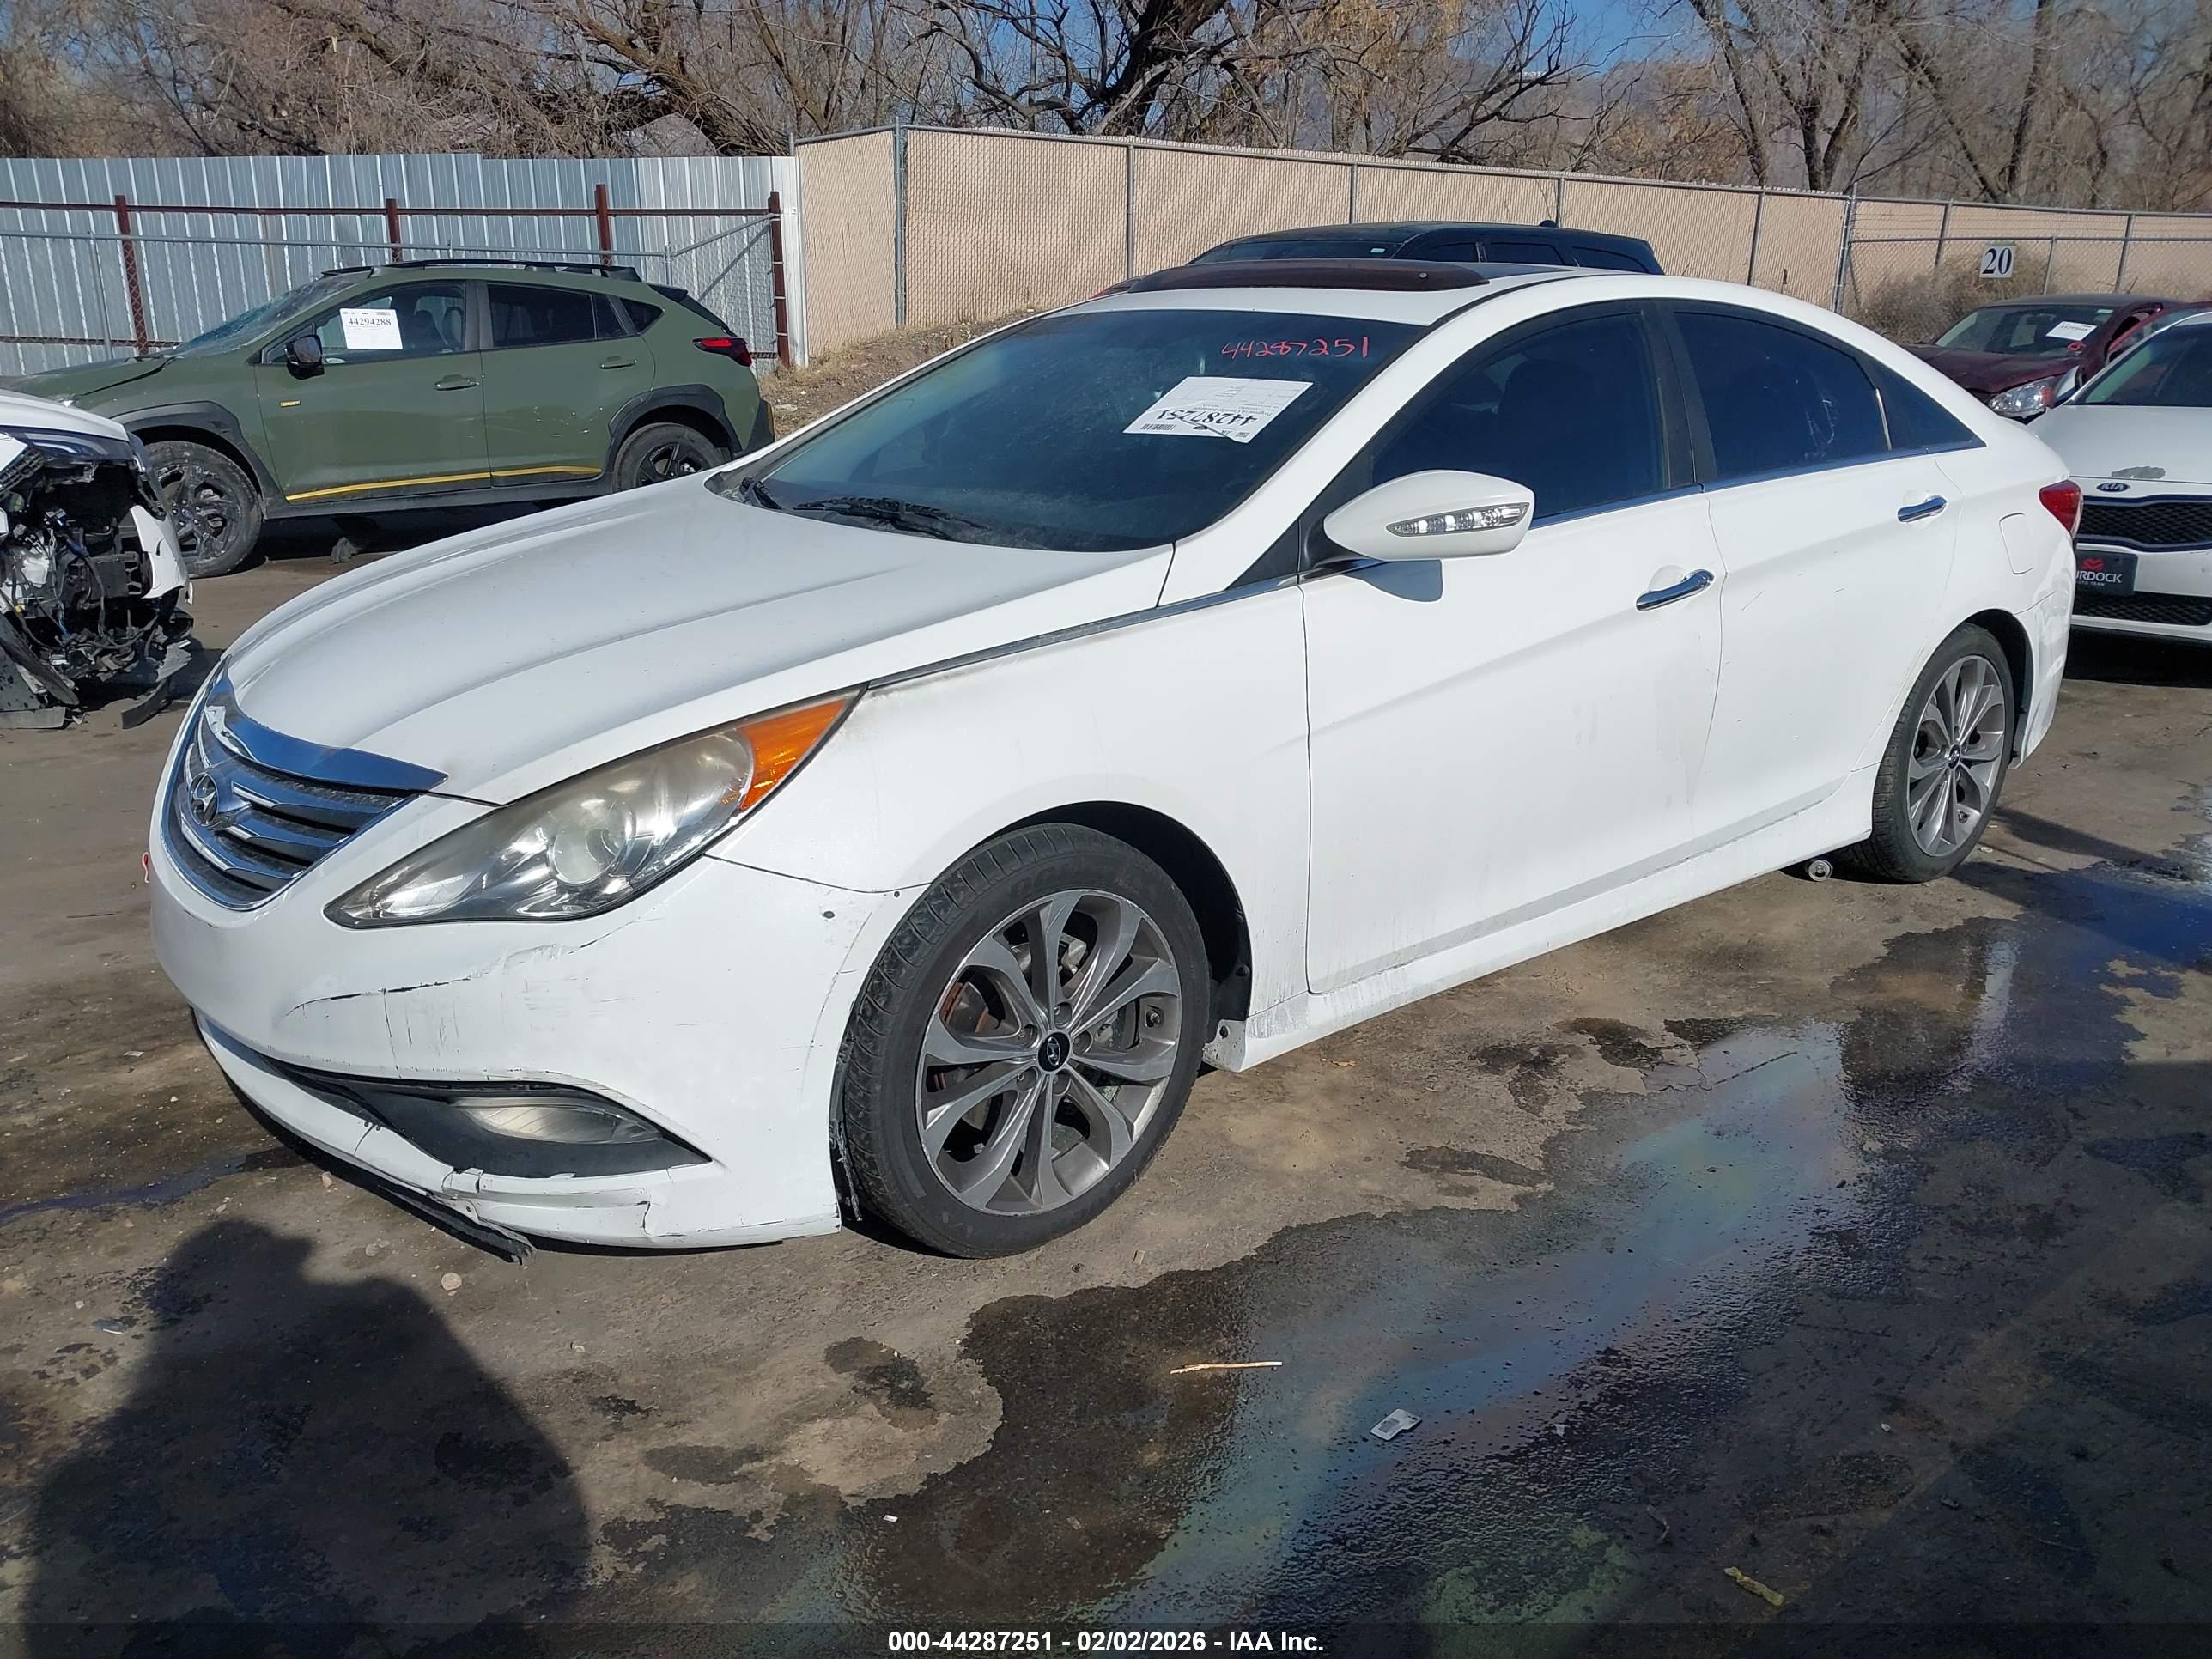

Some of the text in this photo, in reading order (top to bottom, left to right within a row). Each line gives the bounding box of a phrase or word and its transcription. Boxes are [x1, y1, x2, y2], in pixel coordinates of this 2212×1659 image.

[1982, 247, 2013, 275] 20
[348, 317, 392, 326] 44294288
[1221, 336, 1369, 359] 44287251
[1156, 409, 1259, 427] 44287251
